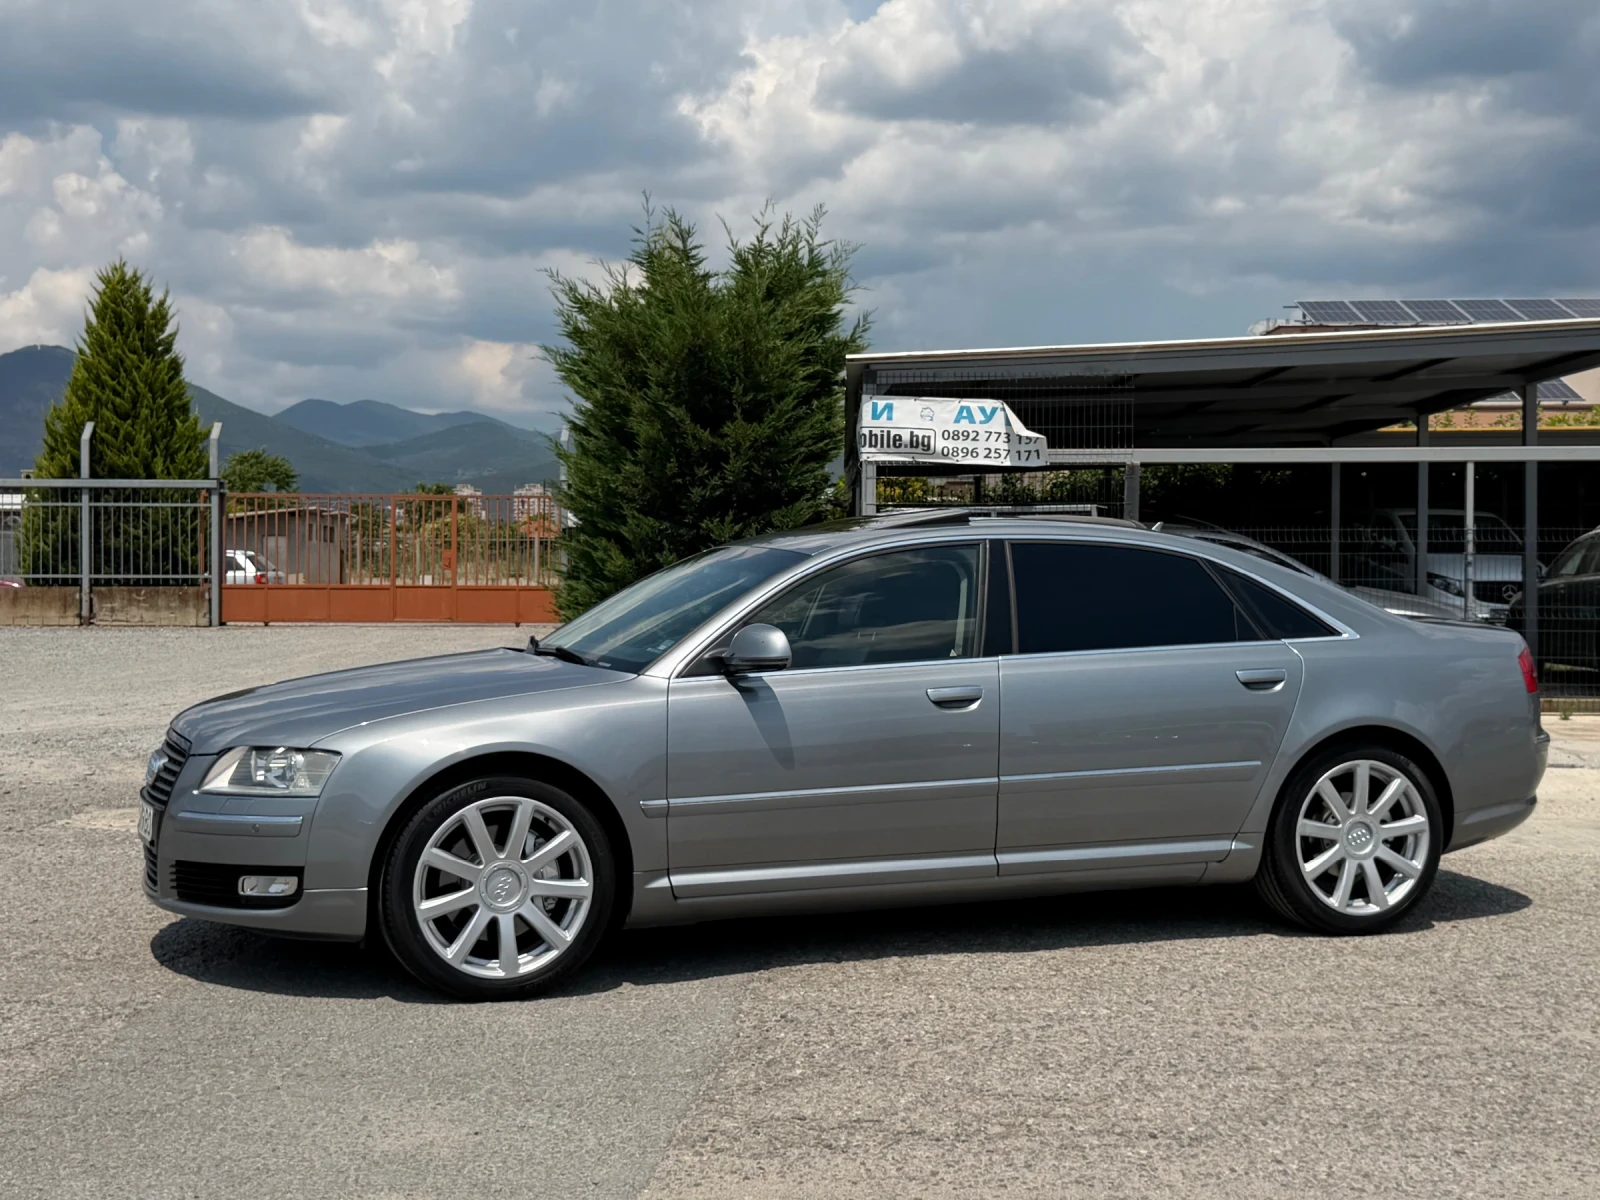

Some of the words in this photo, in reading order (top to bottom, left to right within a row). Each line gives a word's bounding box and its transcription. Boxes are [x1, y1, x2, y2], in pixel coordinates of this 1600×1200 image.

[871, 401, 894, 421] И
[858, 429, 932, 452] obile.bg
[941, 429, 980, 442] 0892
[984, 430, 1011, 444] 773
[941, 446, 979, 459] 0896
[983, 447, 1011, 460] 257
[1015, 449, 1041, 461] 171
[431, 782, 487, 816] MICHELIN
